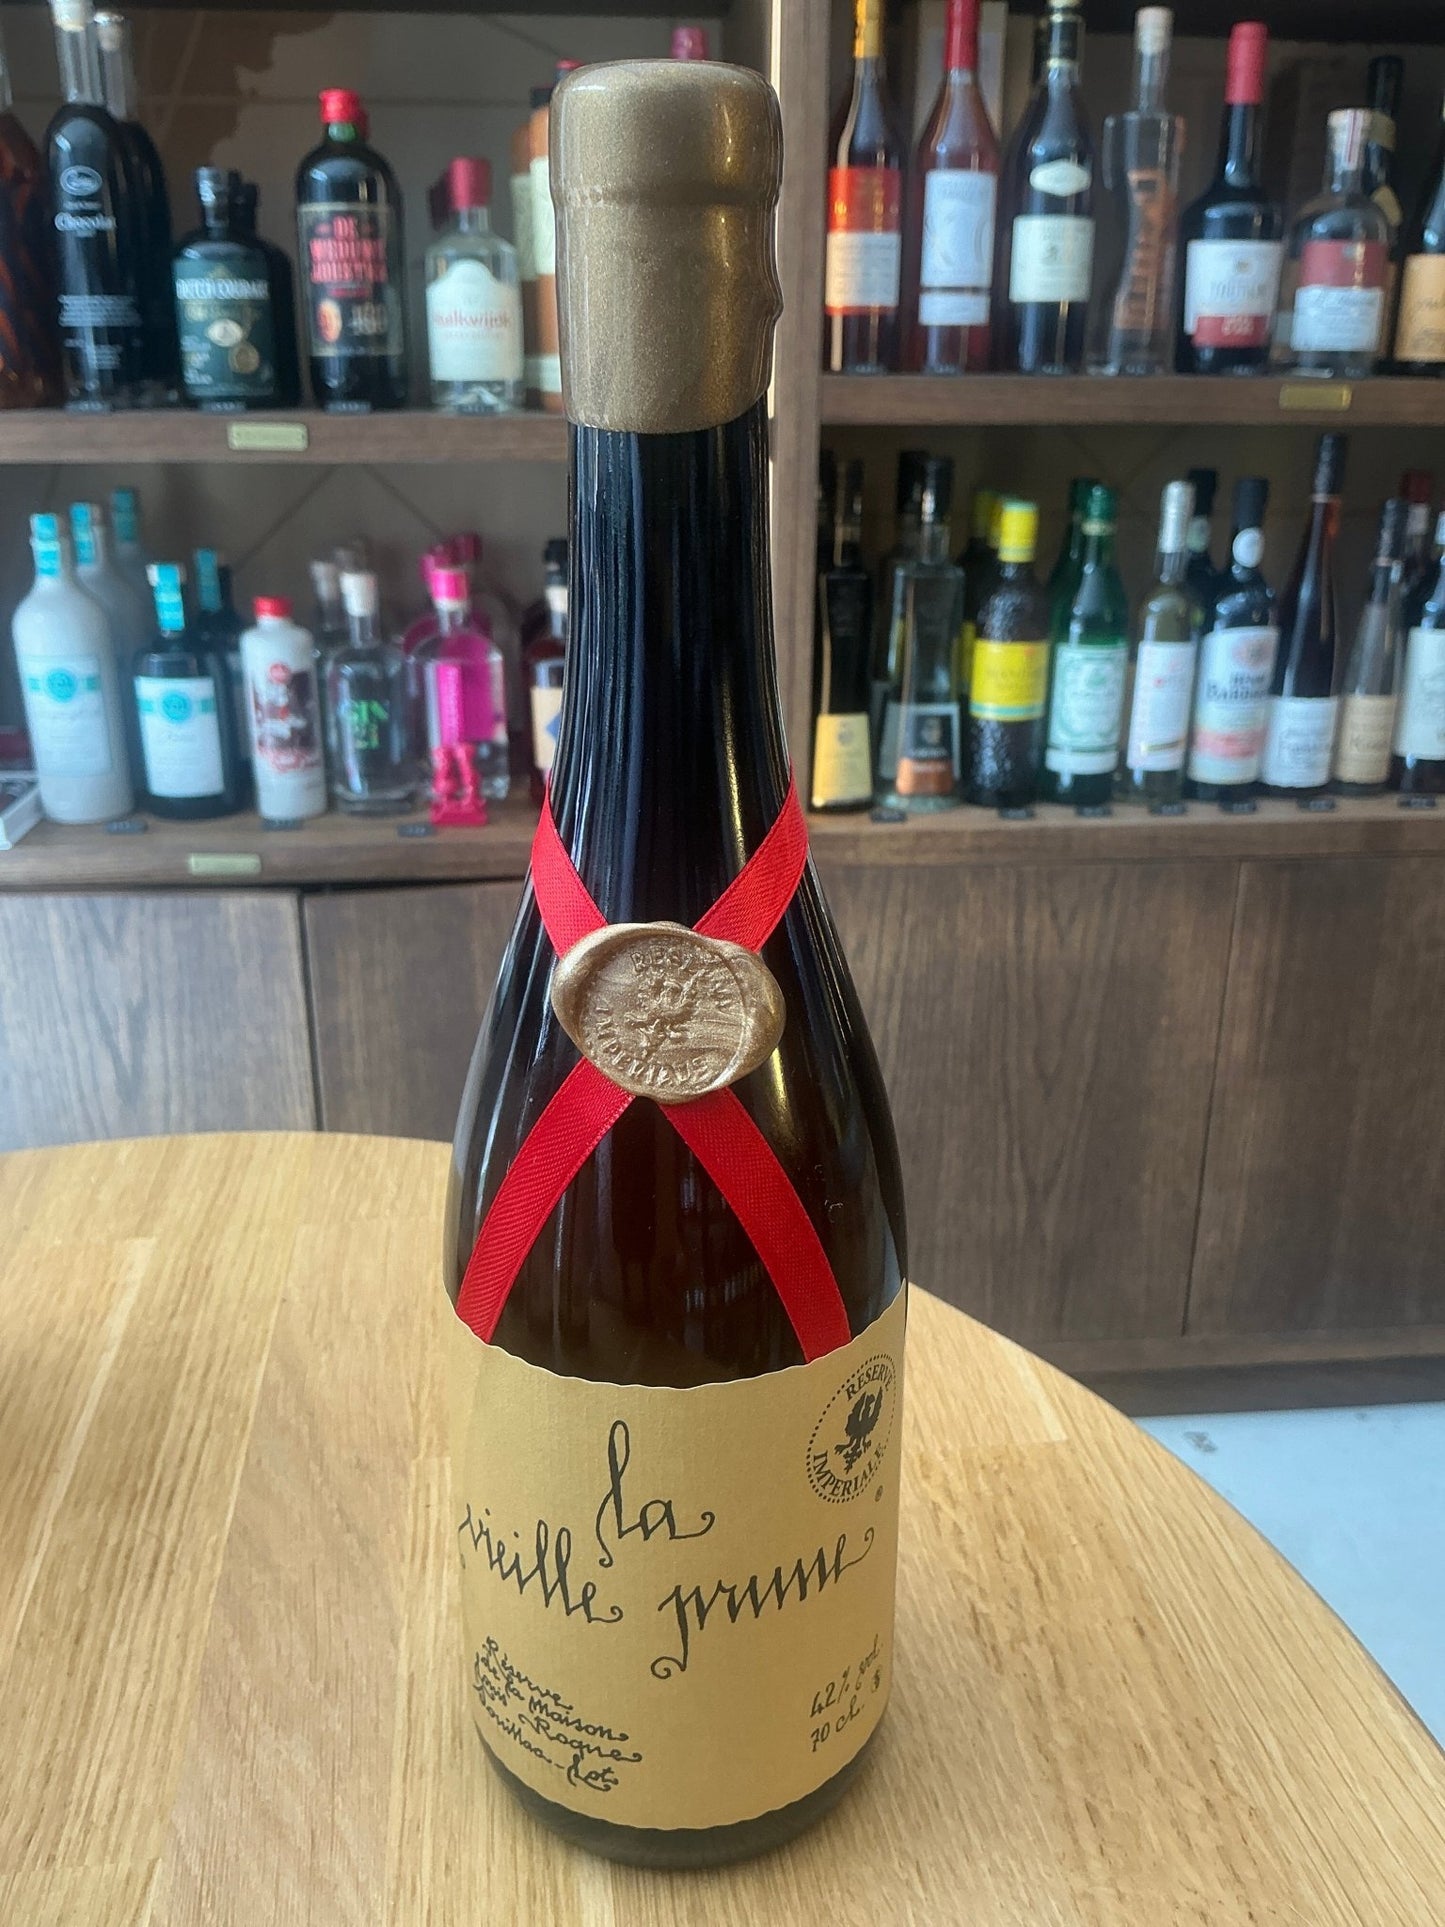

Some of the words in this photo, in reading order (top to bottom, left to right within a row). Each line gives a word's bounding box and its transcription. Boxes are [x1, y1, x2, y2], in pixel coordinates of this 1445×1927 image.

[844, 1363, 893, 1402] RESERVE
[595, 1419, 716, 1568] la
[812, 1442, 883, 1498] IMPERIALE
[457, 1502, 624, 1624] vieille
[649, 1526, 875, 1680] prune
[528, 1695, 630, 1742] Maison
[810, 1721, 831, 1753] 70
